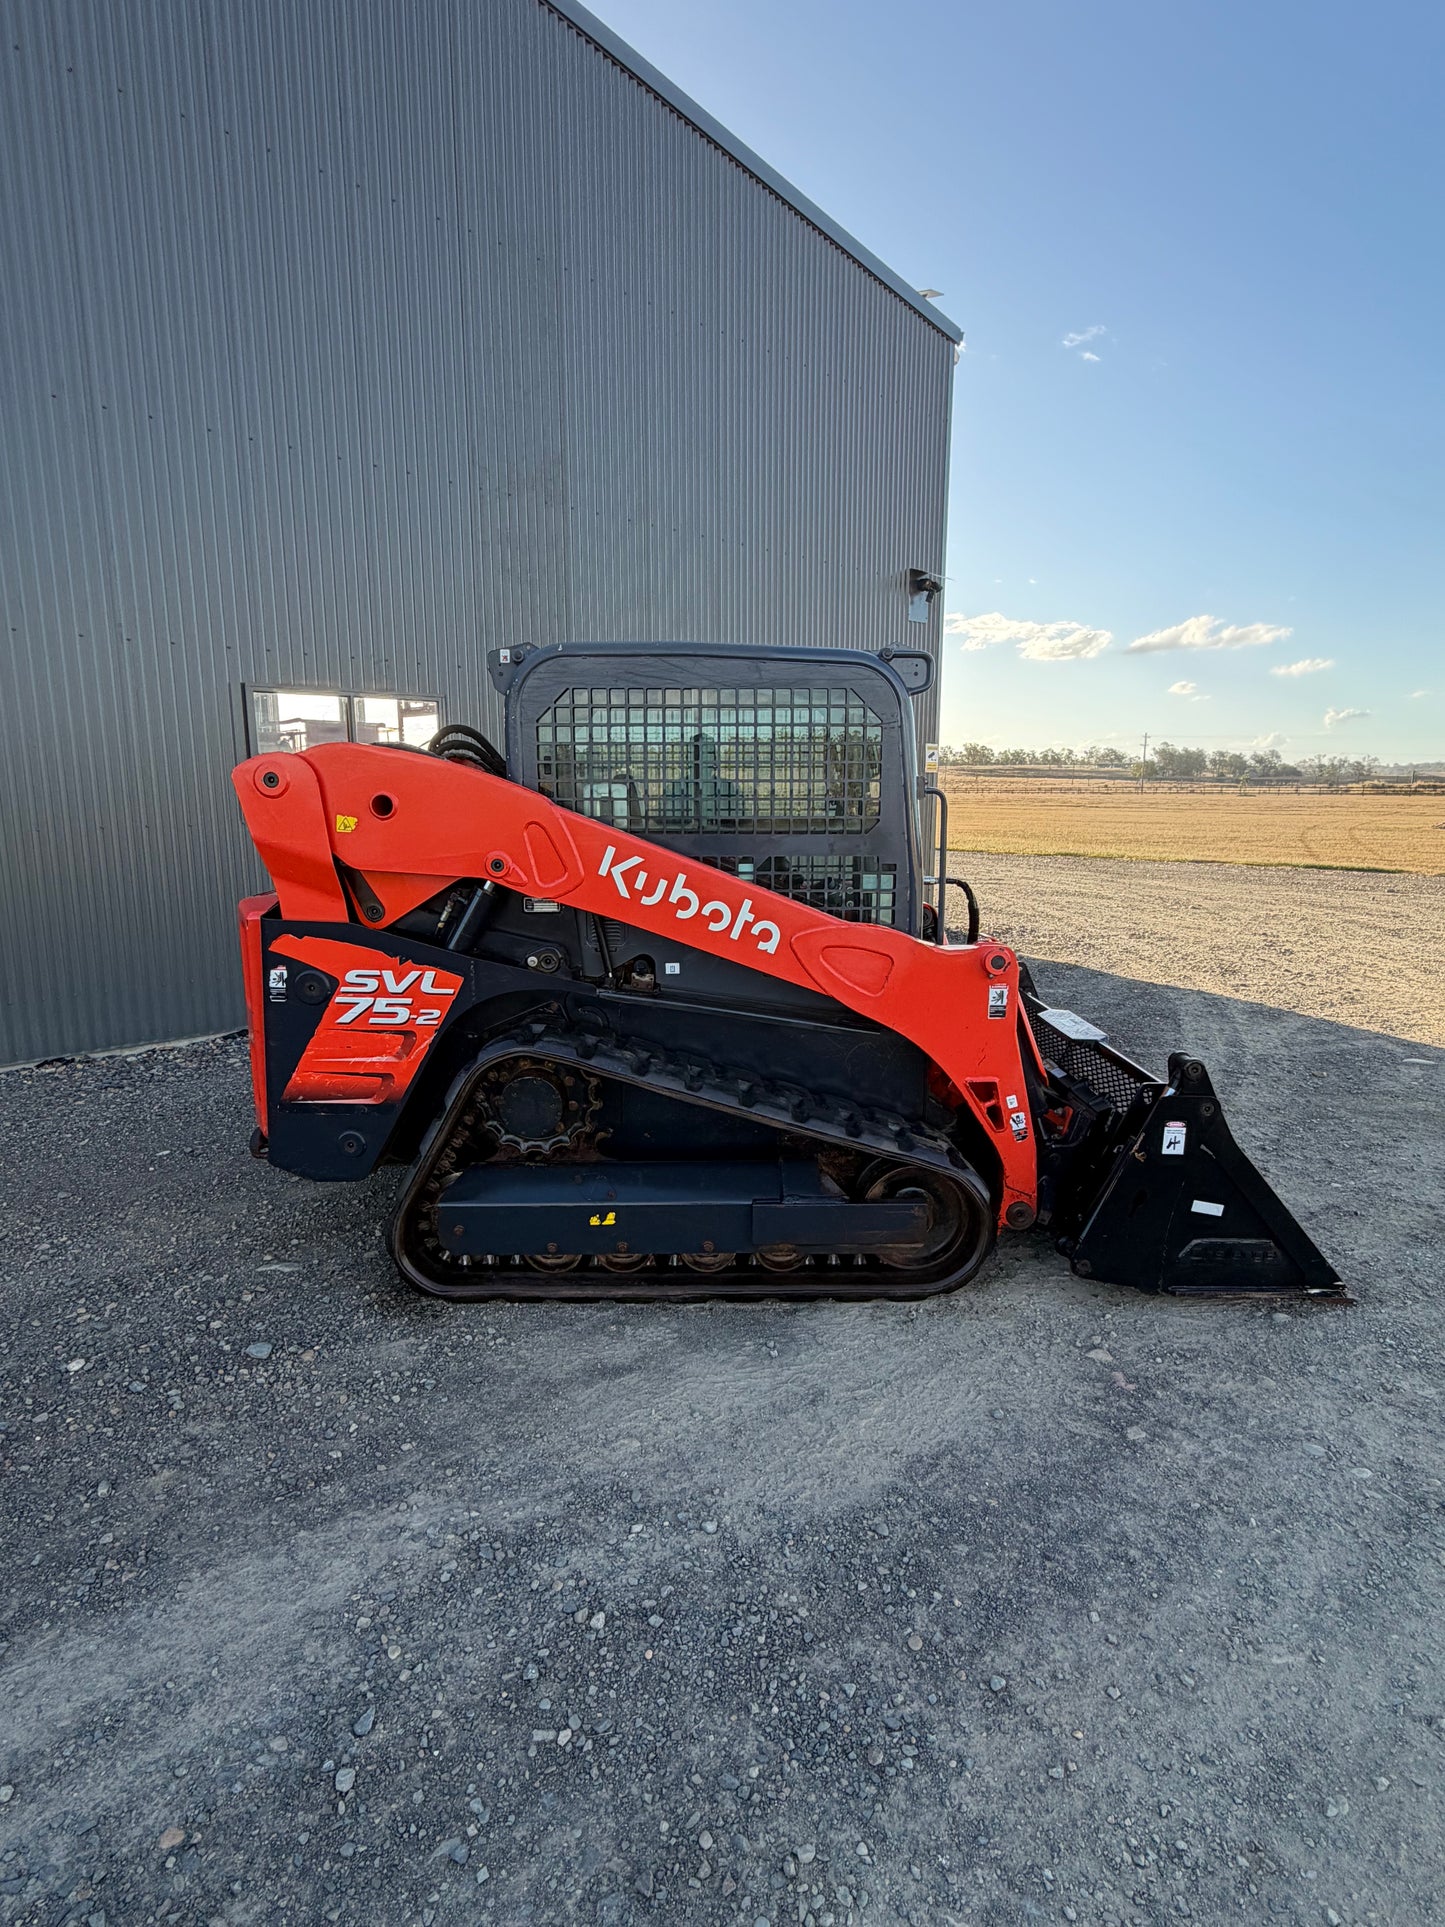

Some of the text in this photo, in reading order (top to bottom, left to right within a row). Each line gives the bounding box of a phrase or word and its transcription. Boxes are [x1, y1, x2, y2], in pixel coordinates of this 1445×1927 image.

[598, 845, 781, 955] Kubota
[340, 969, 455, 995] SVL
[334, 996, 441, 1025] 75-2
